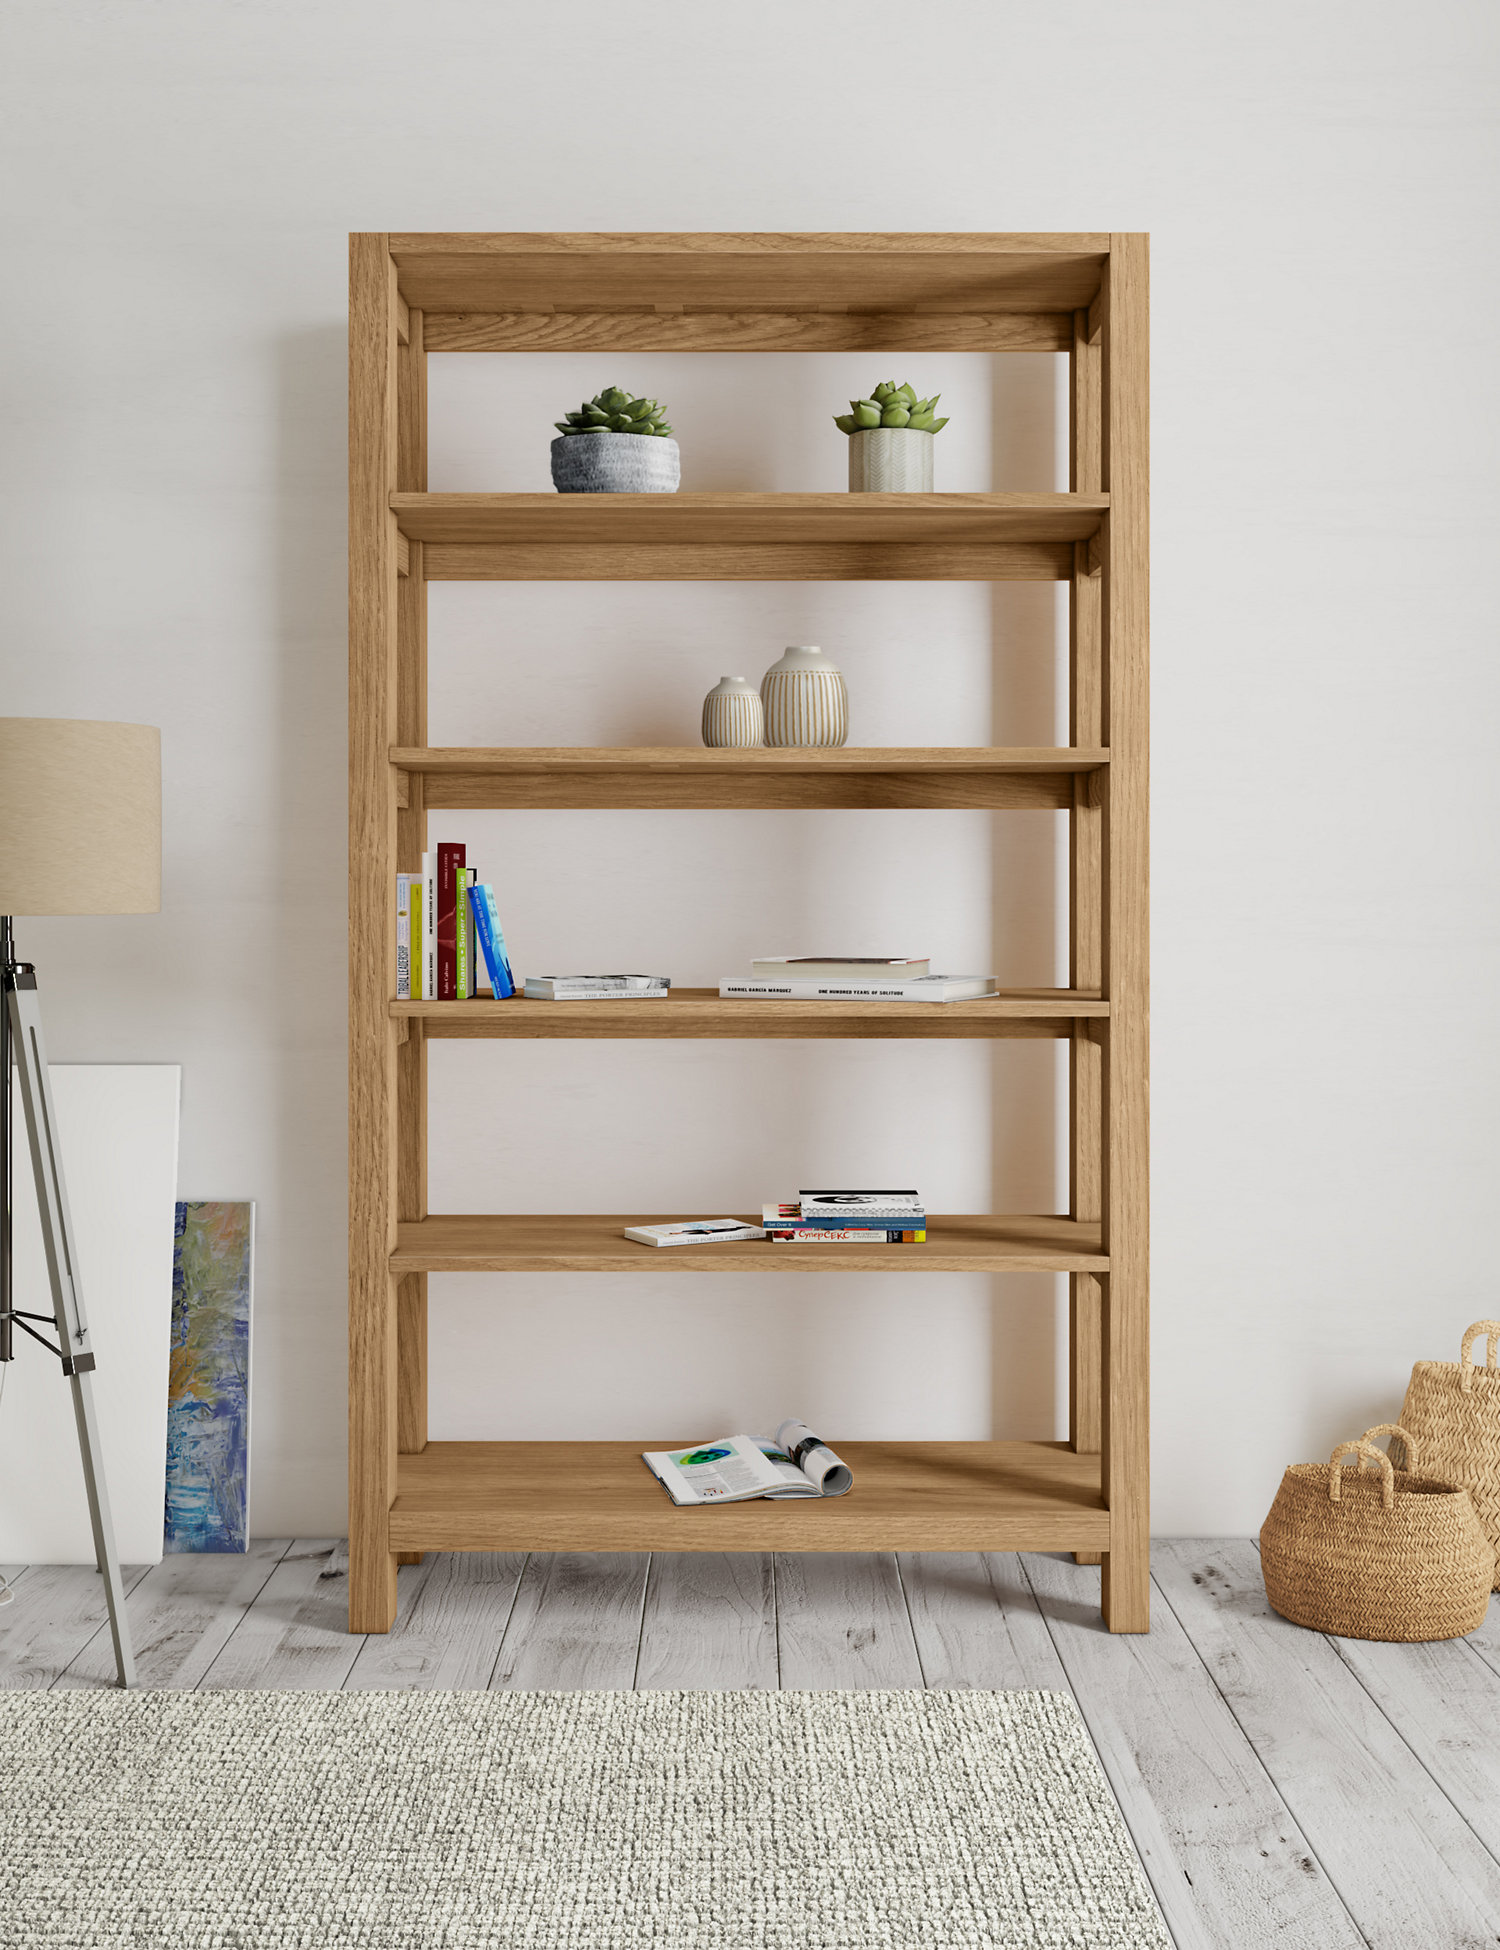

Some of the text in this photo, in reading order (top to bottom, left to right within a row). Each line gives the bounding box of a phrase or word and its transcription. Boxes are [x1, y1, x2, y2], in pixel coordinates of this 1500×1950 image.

[459, 875, 467, 911] Simple
[459, 918, 467, 949] Super
[398, 945, 408, 976] LEADERSHIP
[398, 976, 408, 995] TRIBAL
[798, 1230, 850, 1240] СуперСЕКС
